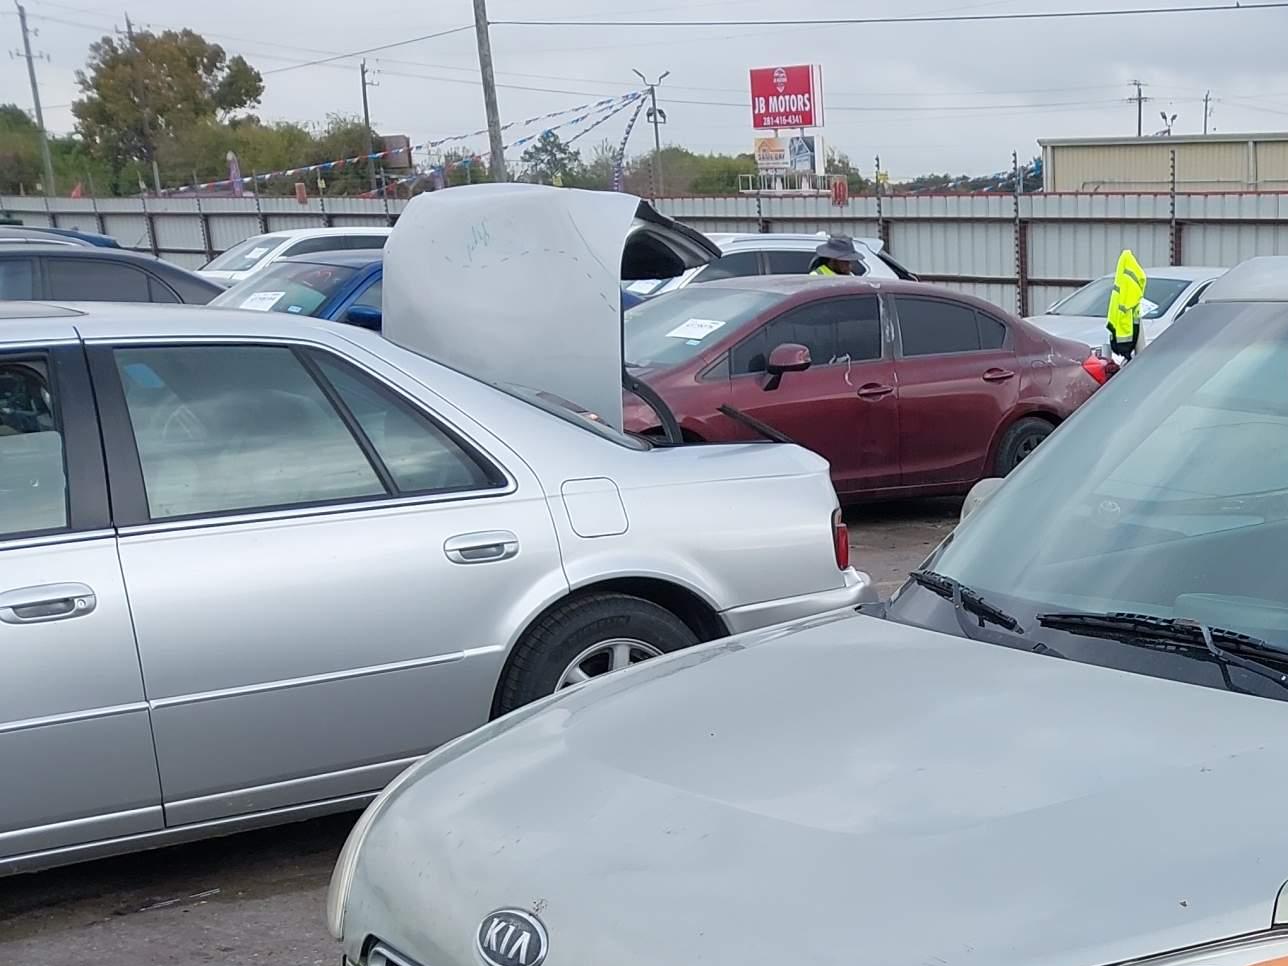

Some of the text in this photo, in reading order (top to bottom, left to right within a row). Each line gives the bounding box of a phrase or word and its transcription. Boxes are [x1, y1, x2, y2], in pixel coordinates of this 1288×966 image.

[754, 94, 811, 114] JB MOTORS
[483, 917, 531, 965] KIA
